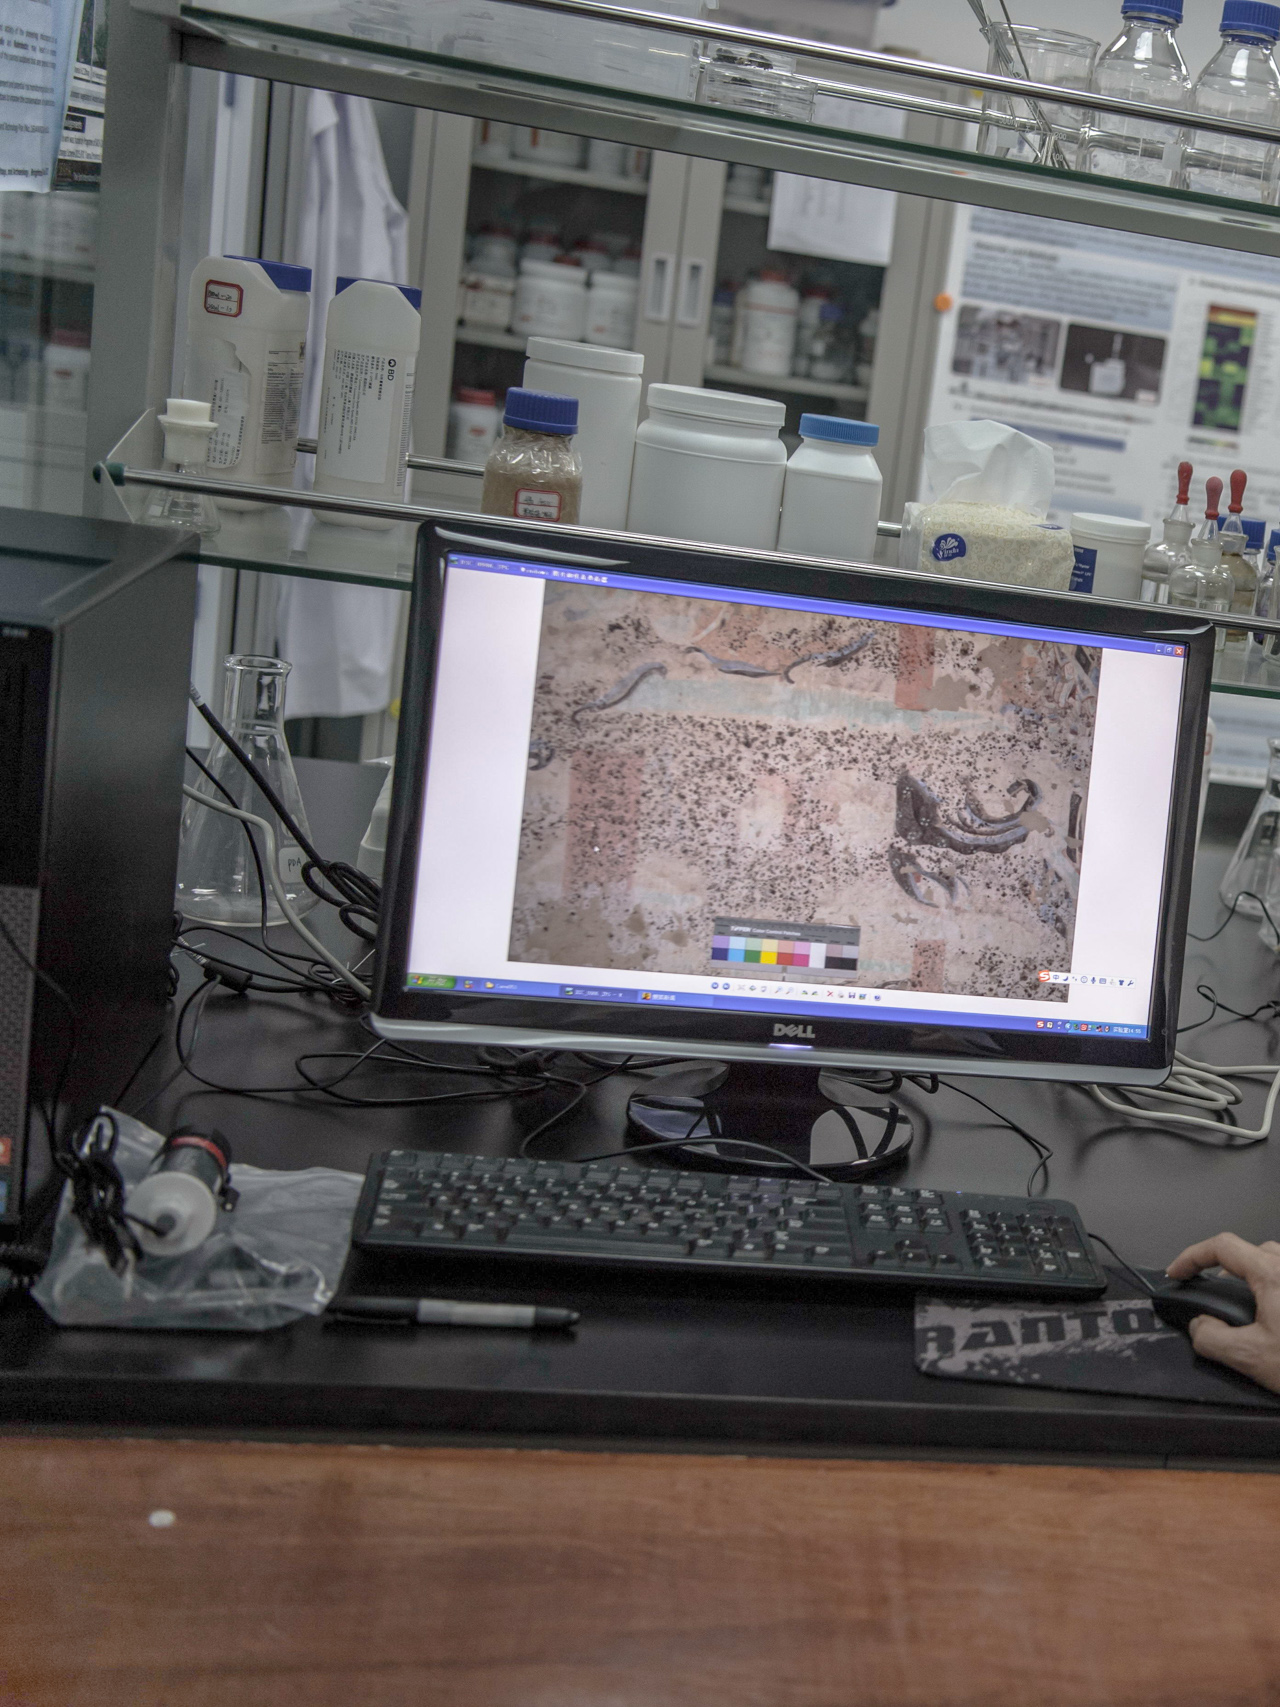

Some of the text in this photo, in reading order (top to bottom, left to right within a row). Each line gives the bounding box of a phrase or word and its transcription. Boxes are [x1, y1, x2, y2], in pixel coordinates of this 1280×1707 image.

[1055, 131, 1067, 141] 200
[387, 368, 395, 381] BD
[287, 857, 302, 872] PDA
[773, 1023, 816, 1039] DELL
[914, 1308, 1158, 1358] RANTO
